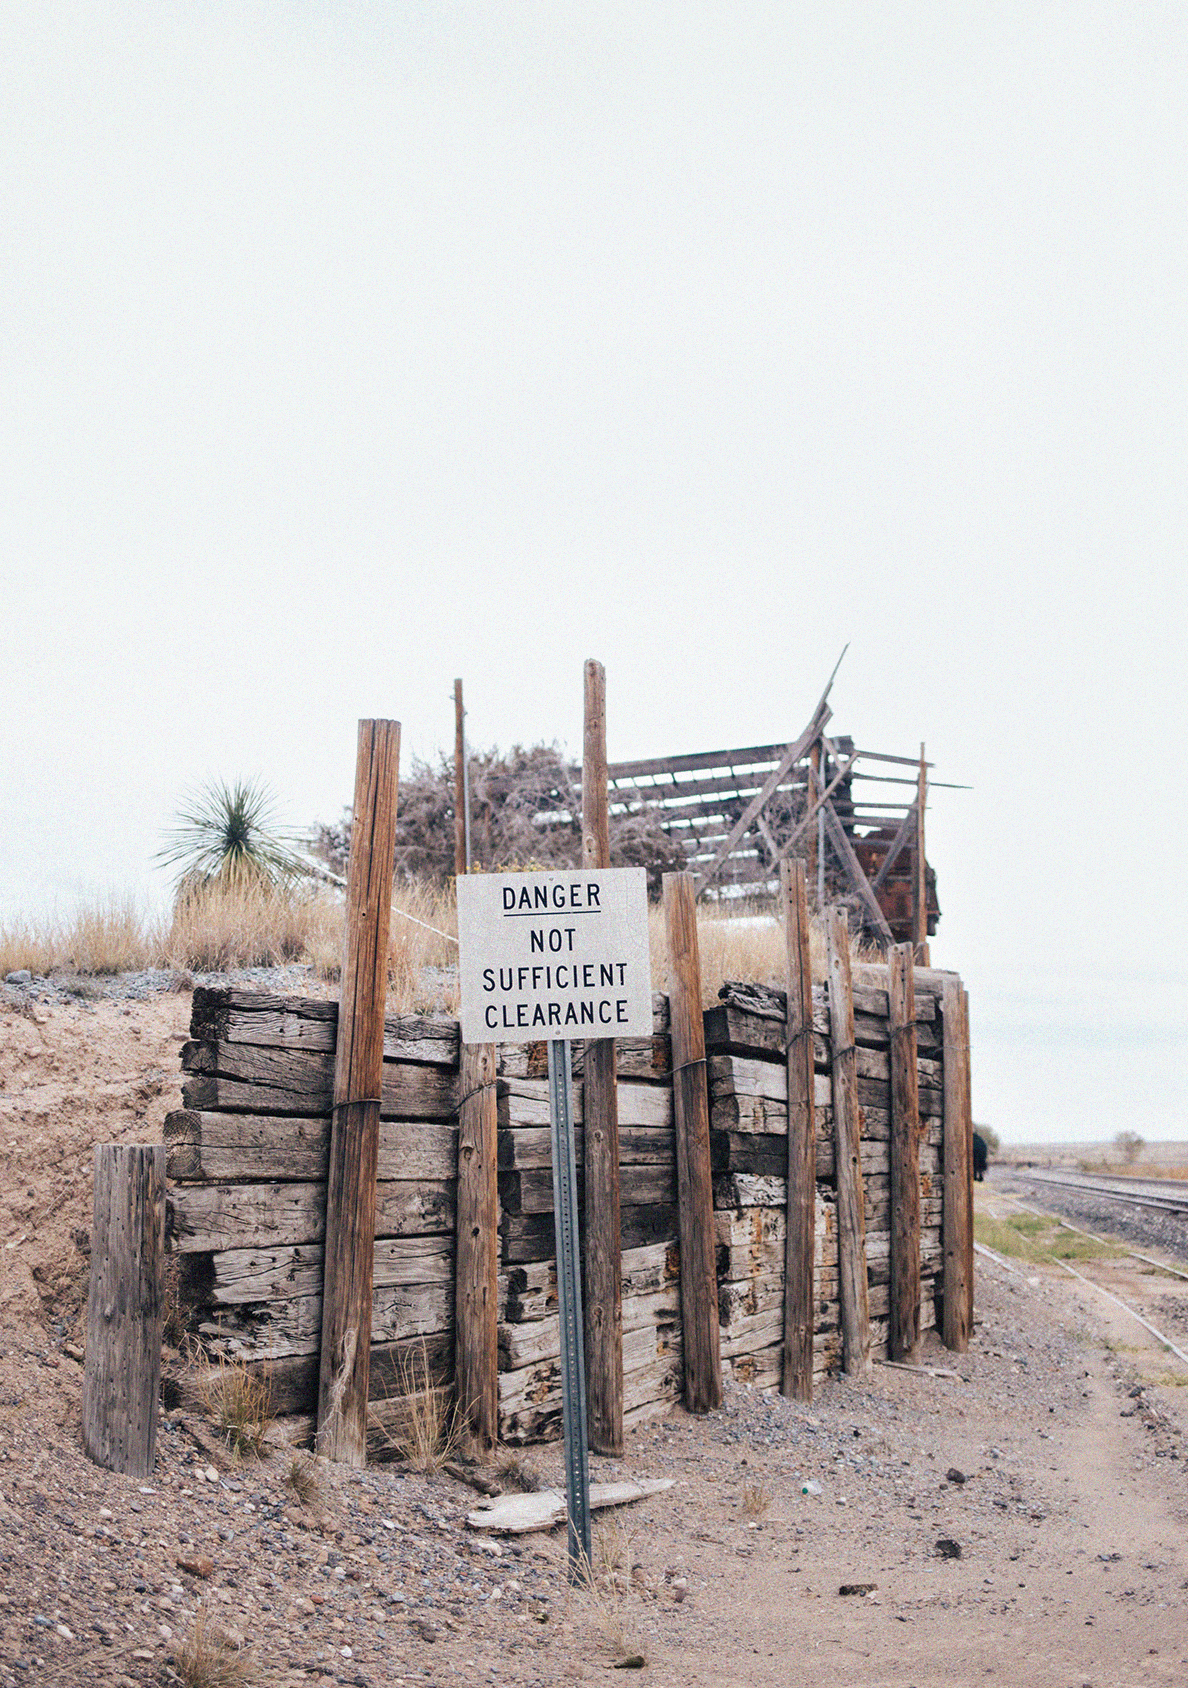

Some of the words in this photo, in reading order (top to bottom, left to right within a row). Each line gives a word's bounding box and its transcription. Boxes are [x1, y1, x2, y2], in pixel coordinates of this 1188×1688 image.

[503, 883, 601, 910] DANGER
[530, 928, 576, 953] NOT
[482, 963, 628, 992] SUFFICIENT
[485, 1000, 629, 1029] CLEARANCE
